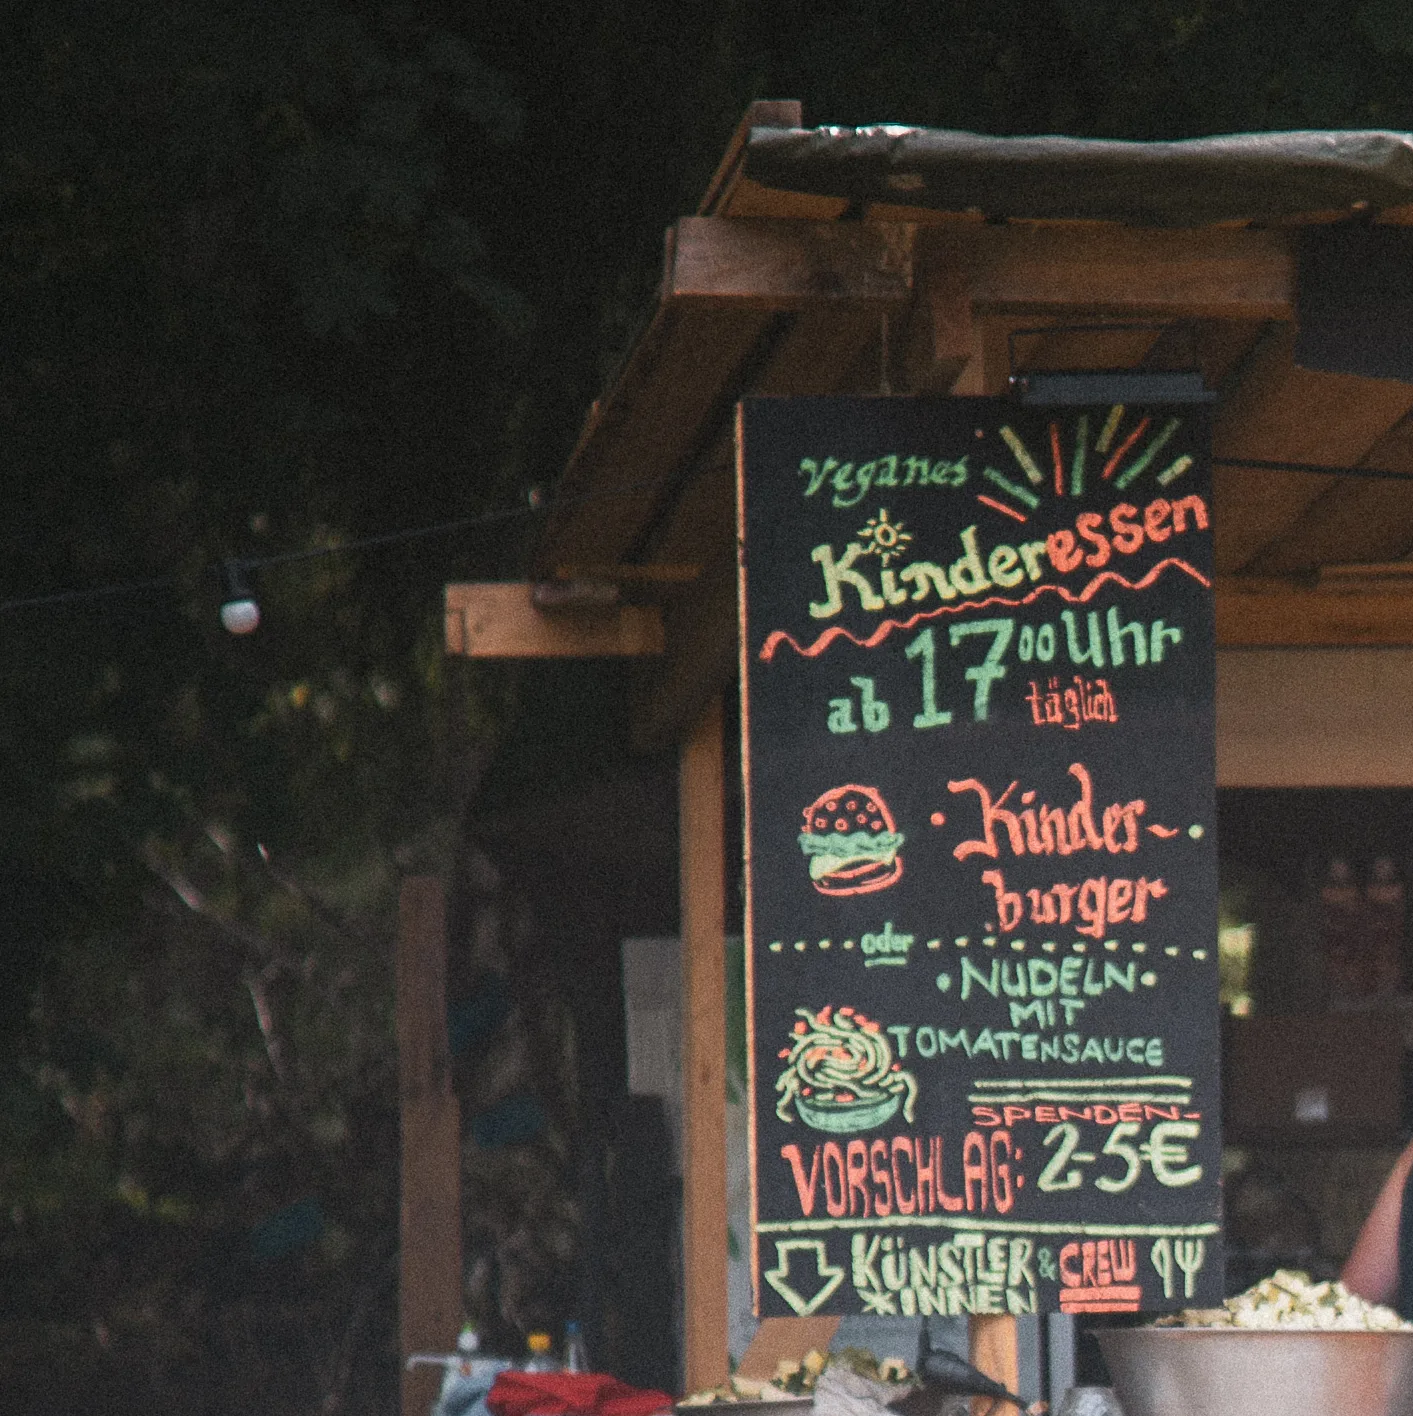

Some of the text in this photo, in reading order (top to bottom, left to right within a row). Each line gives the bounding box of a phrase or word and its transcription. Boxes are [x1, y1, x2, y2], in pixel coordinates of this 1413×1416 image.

[808, 494, 1209, 619] Kinderessen
[827, 676, 890, 734] ab
[1025, 676, 1119, 730] täglich
[982, 869, 1169, 938] burger
[860, 923, 913, 956] oder
[961, 956, 1136, 1001] NUDELN
[1010, 999, 1085, 1029] MIT
[886, 1025, 1164, 1067] TOMATENSAUCE
[852, 1233, 1035, 1291] KÜNSTLER
[1059, 1239, 1137, 1288] CREW
